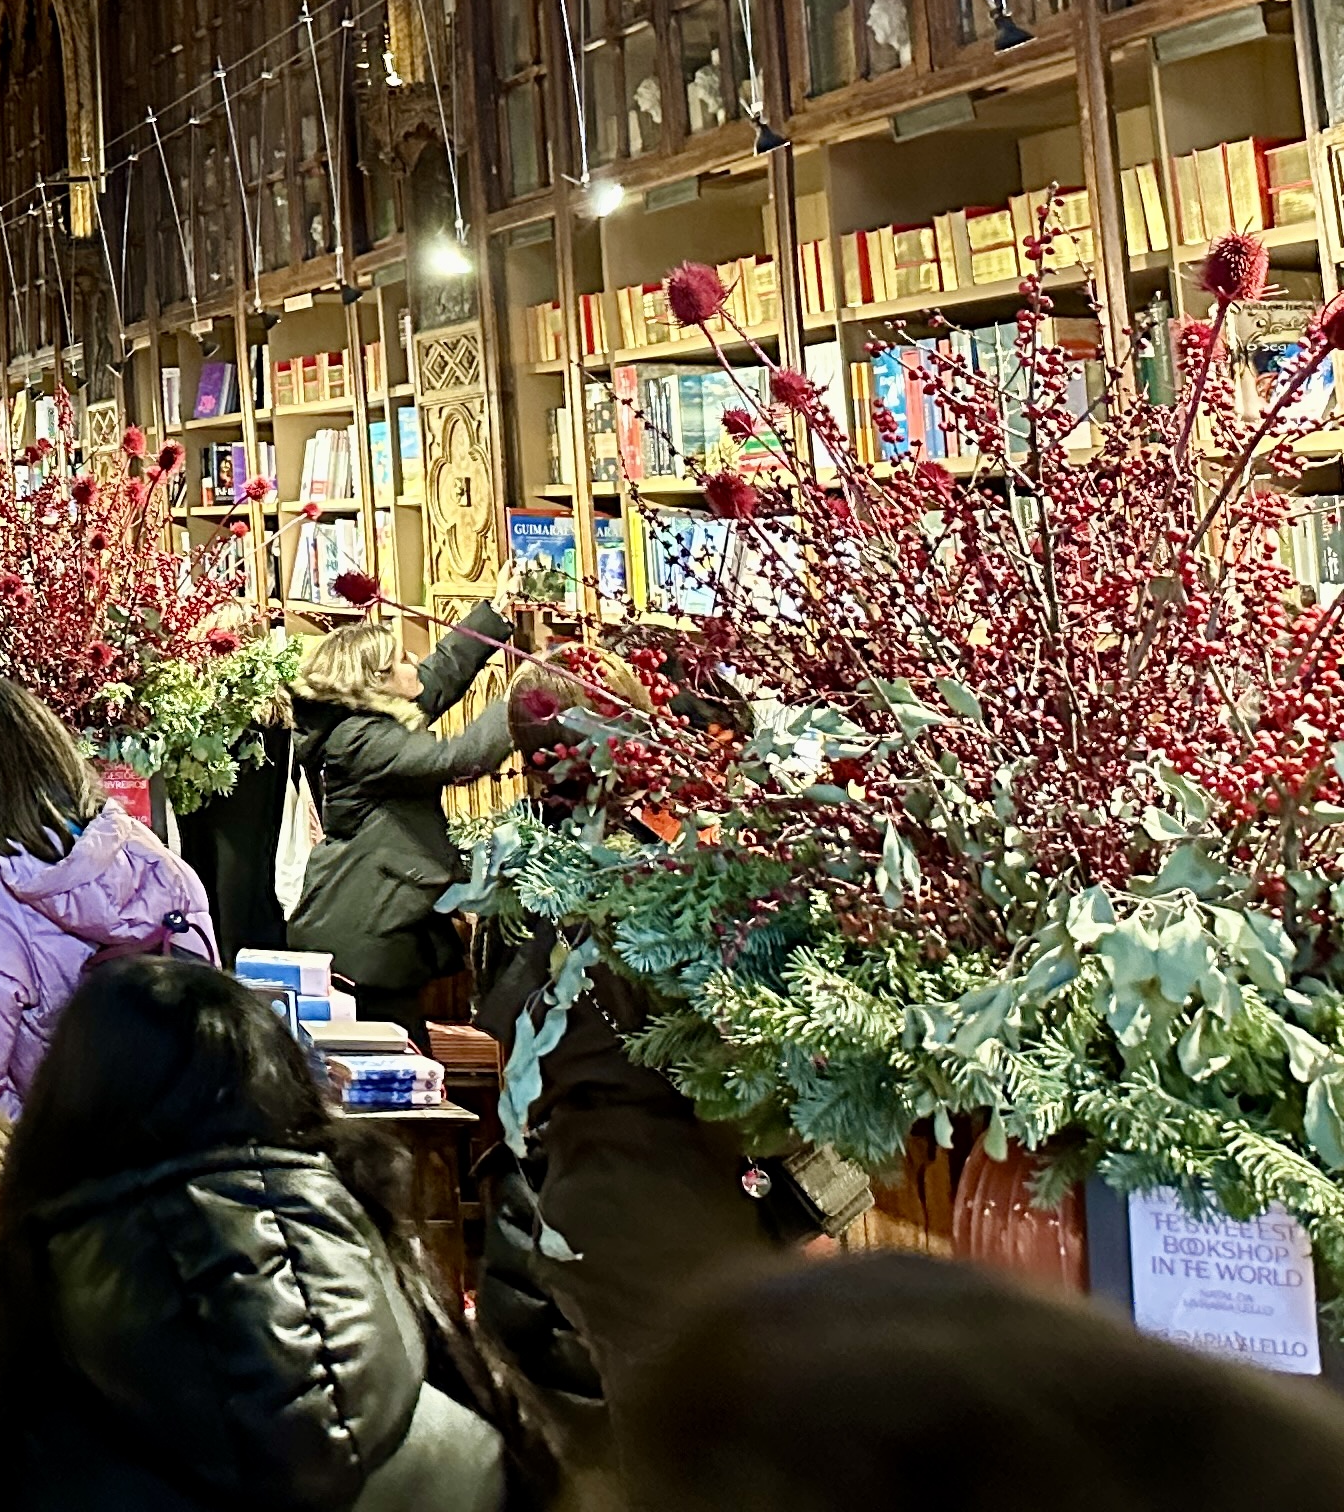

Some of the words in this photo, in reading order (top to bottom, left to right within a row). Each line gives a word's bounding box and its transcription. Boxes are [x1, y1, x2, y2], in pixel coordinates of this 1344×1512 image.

[1163, 1235, 1289, 1263] BOOKSHOP
[1151, 1256, 1176, 1276] IN
[1215, 1262, 1304, 1288] WORLD
